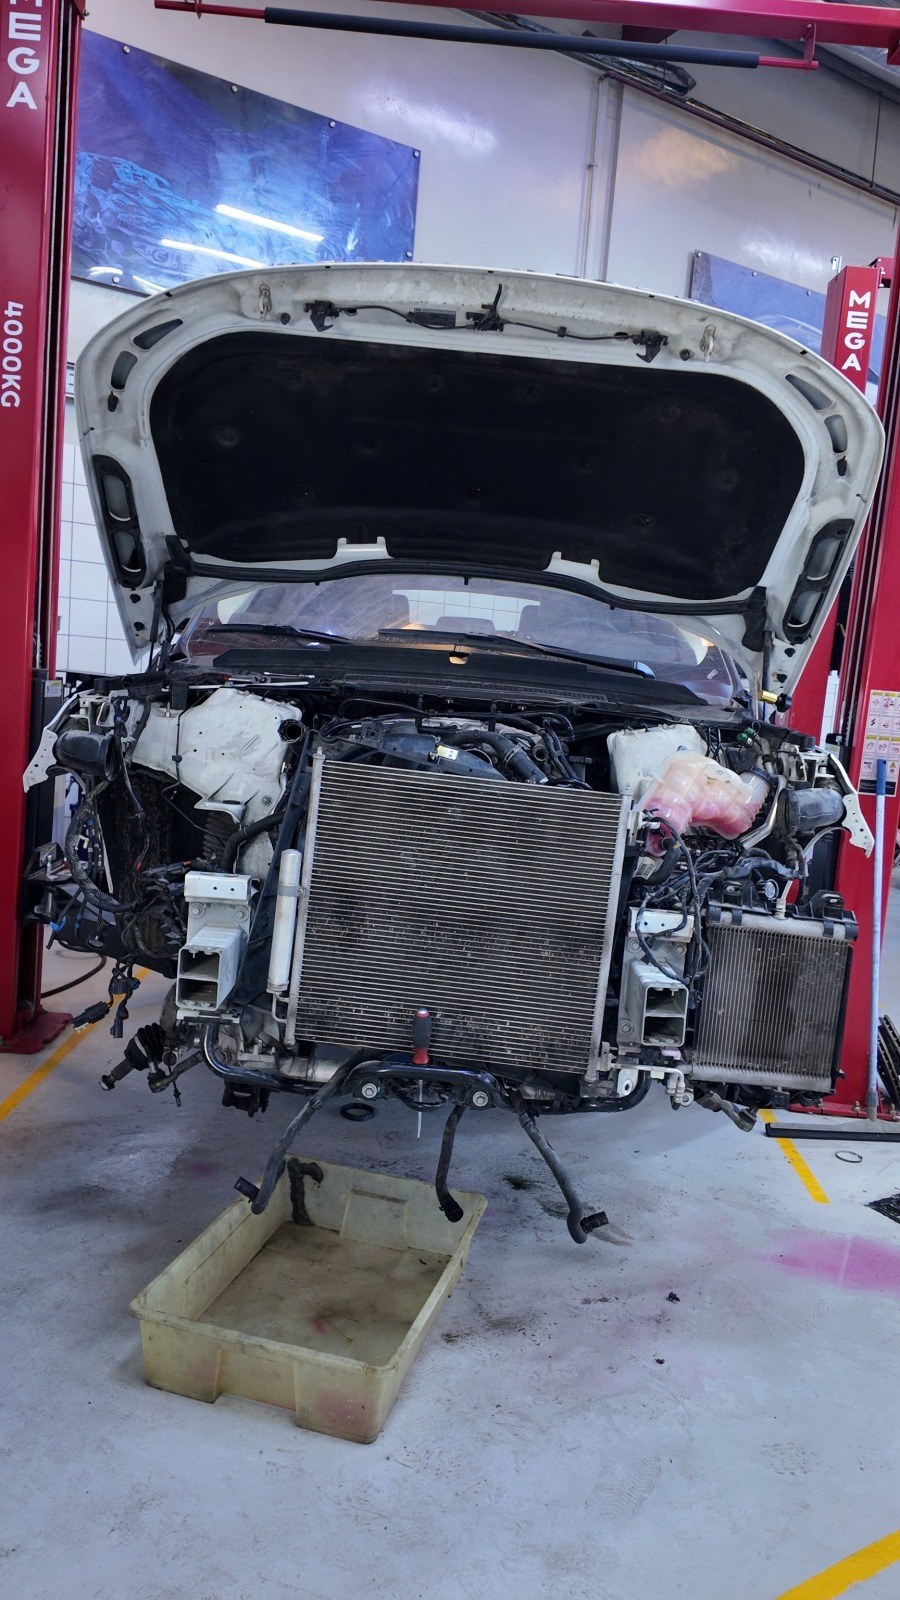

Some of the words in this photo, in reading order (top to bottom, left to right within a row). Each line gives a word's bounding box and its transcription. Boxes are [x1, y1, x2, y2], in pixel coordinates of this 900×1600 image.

[6, 0, 42, 110] EGA
[0, 301, 24, 408] 4000KG
[841, 290, 871, 371] MEGA
